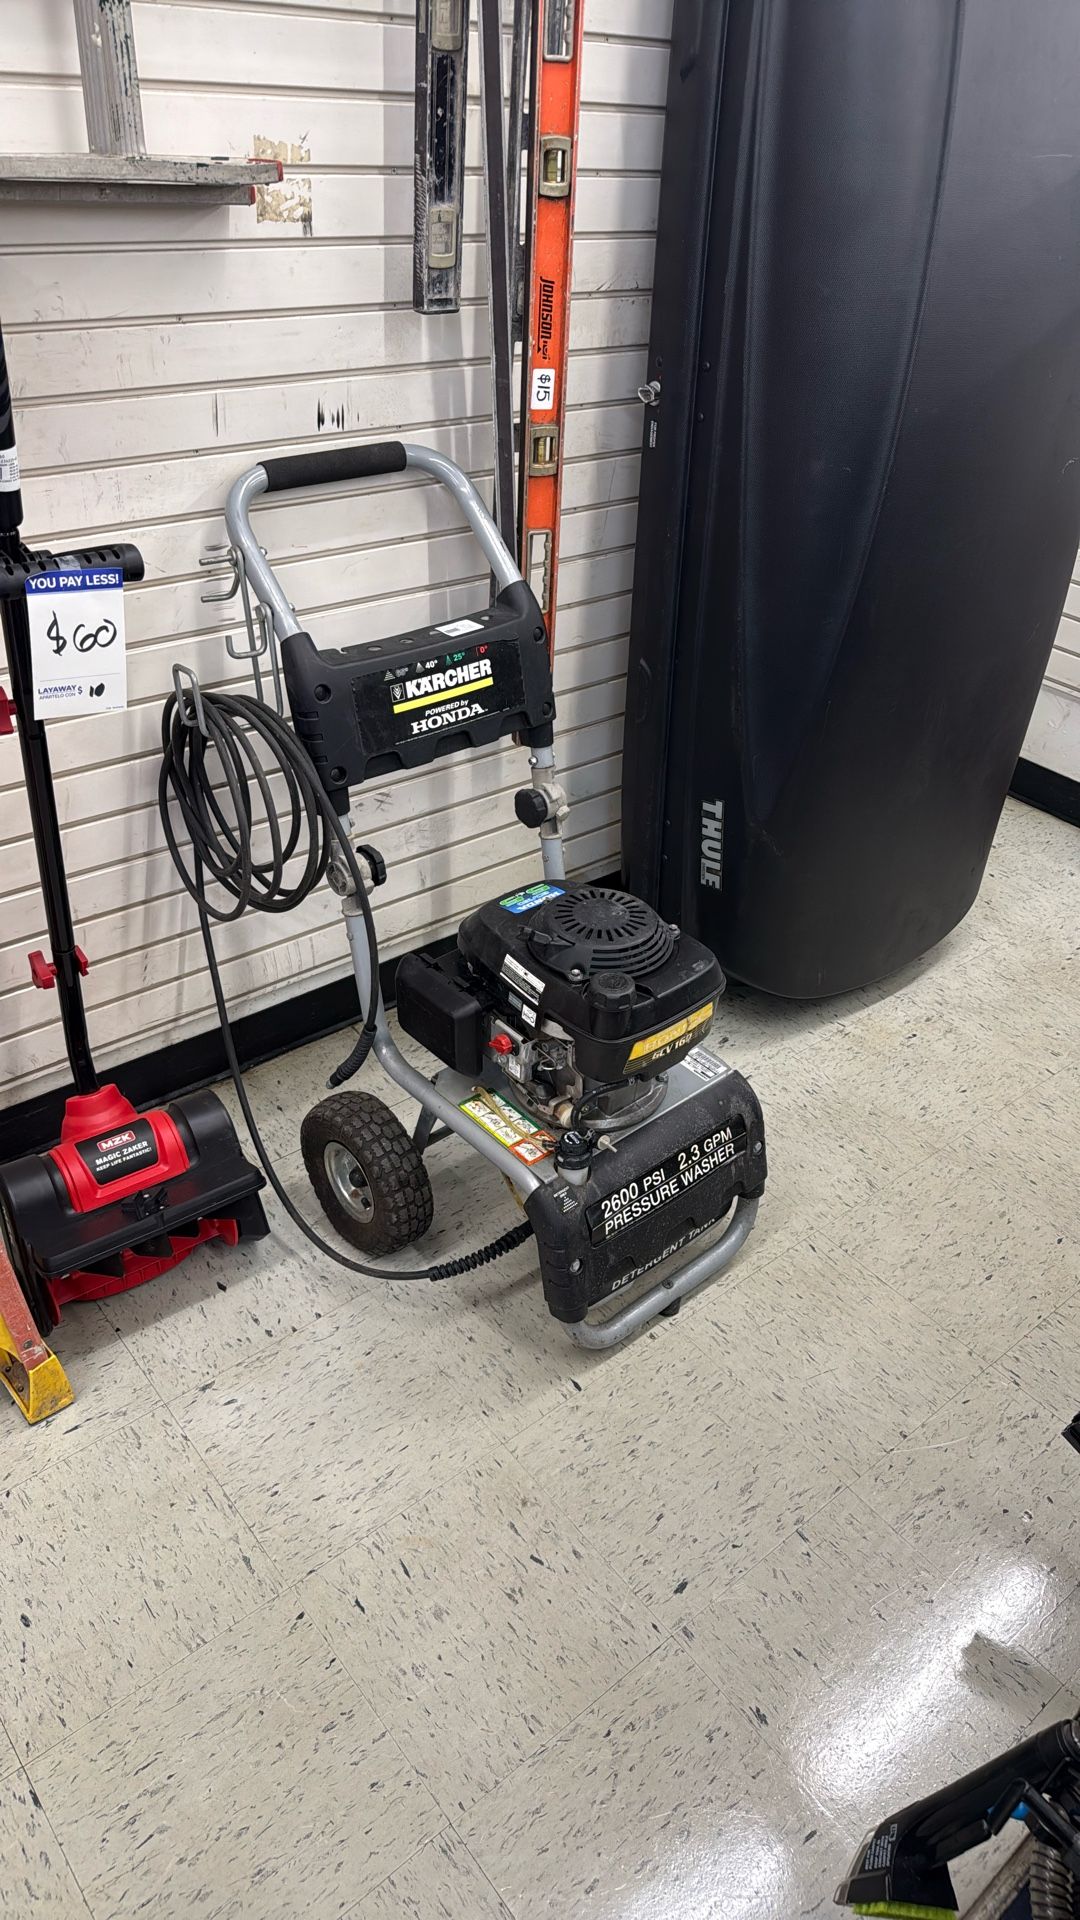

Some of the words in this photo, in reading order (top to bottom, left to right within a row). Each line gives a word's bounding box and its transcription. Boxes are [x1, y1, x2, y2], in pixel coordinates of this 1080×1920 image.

[540, 276, 555, 340] JOHNSON
[536, 373, 552, 402] $15
[29, 577, 57, 589] YOU
[60, 575, 83, 588] PAY
[86, 573, 119, 586] LESS!
[453, 652, 466, 662] 25°
[38, 685, 77, 695] LAYAWAY
[77, 686, 83, 695] $
[405, 658, 493, 699] KÄRCHER
[410, 703, 484, 735] HONDA
[425, 702, 460, 717] POWERED
[460, 699, 469, 707] by
[700, 800, 723, 889] THULE
[95, 1151, 122, 1166] MAGIC
[122, 1140, 148, 1155] ZAKER
[101, 1133, 131, 1150] MZK
[601, 1182, 639, 1219] 2600
[643, 1168, 666, 1192] PSI
[677, 1144, 700, 1170] 2.3
[704, 1127, 733, 1153] GPM
[605, 1179, 680, 1235] PRESSURE
[680, 1143, 735, 1186] WASHER
